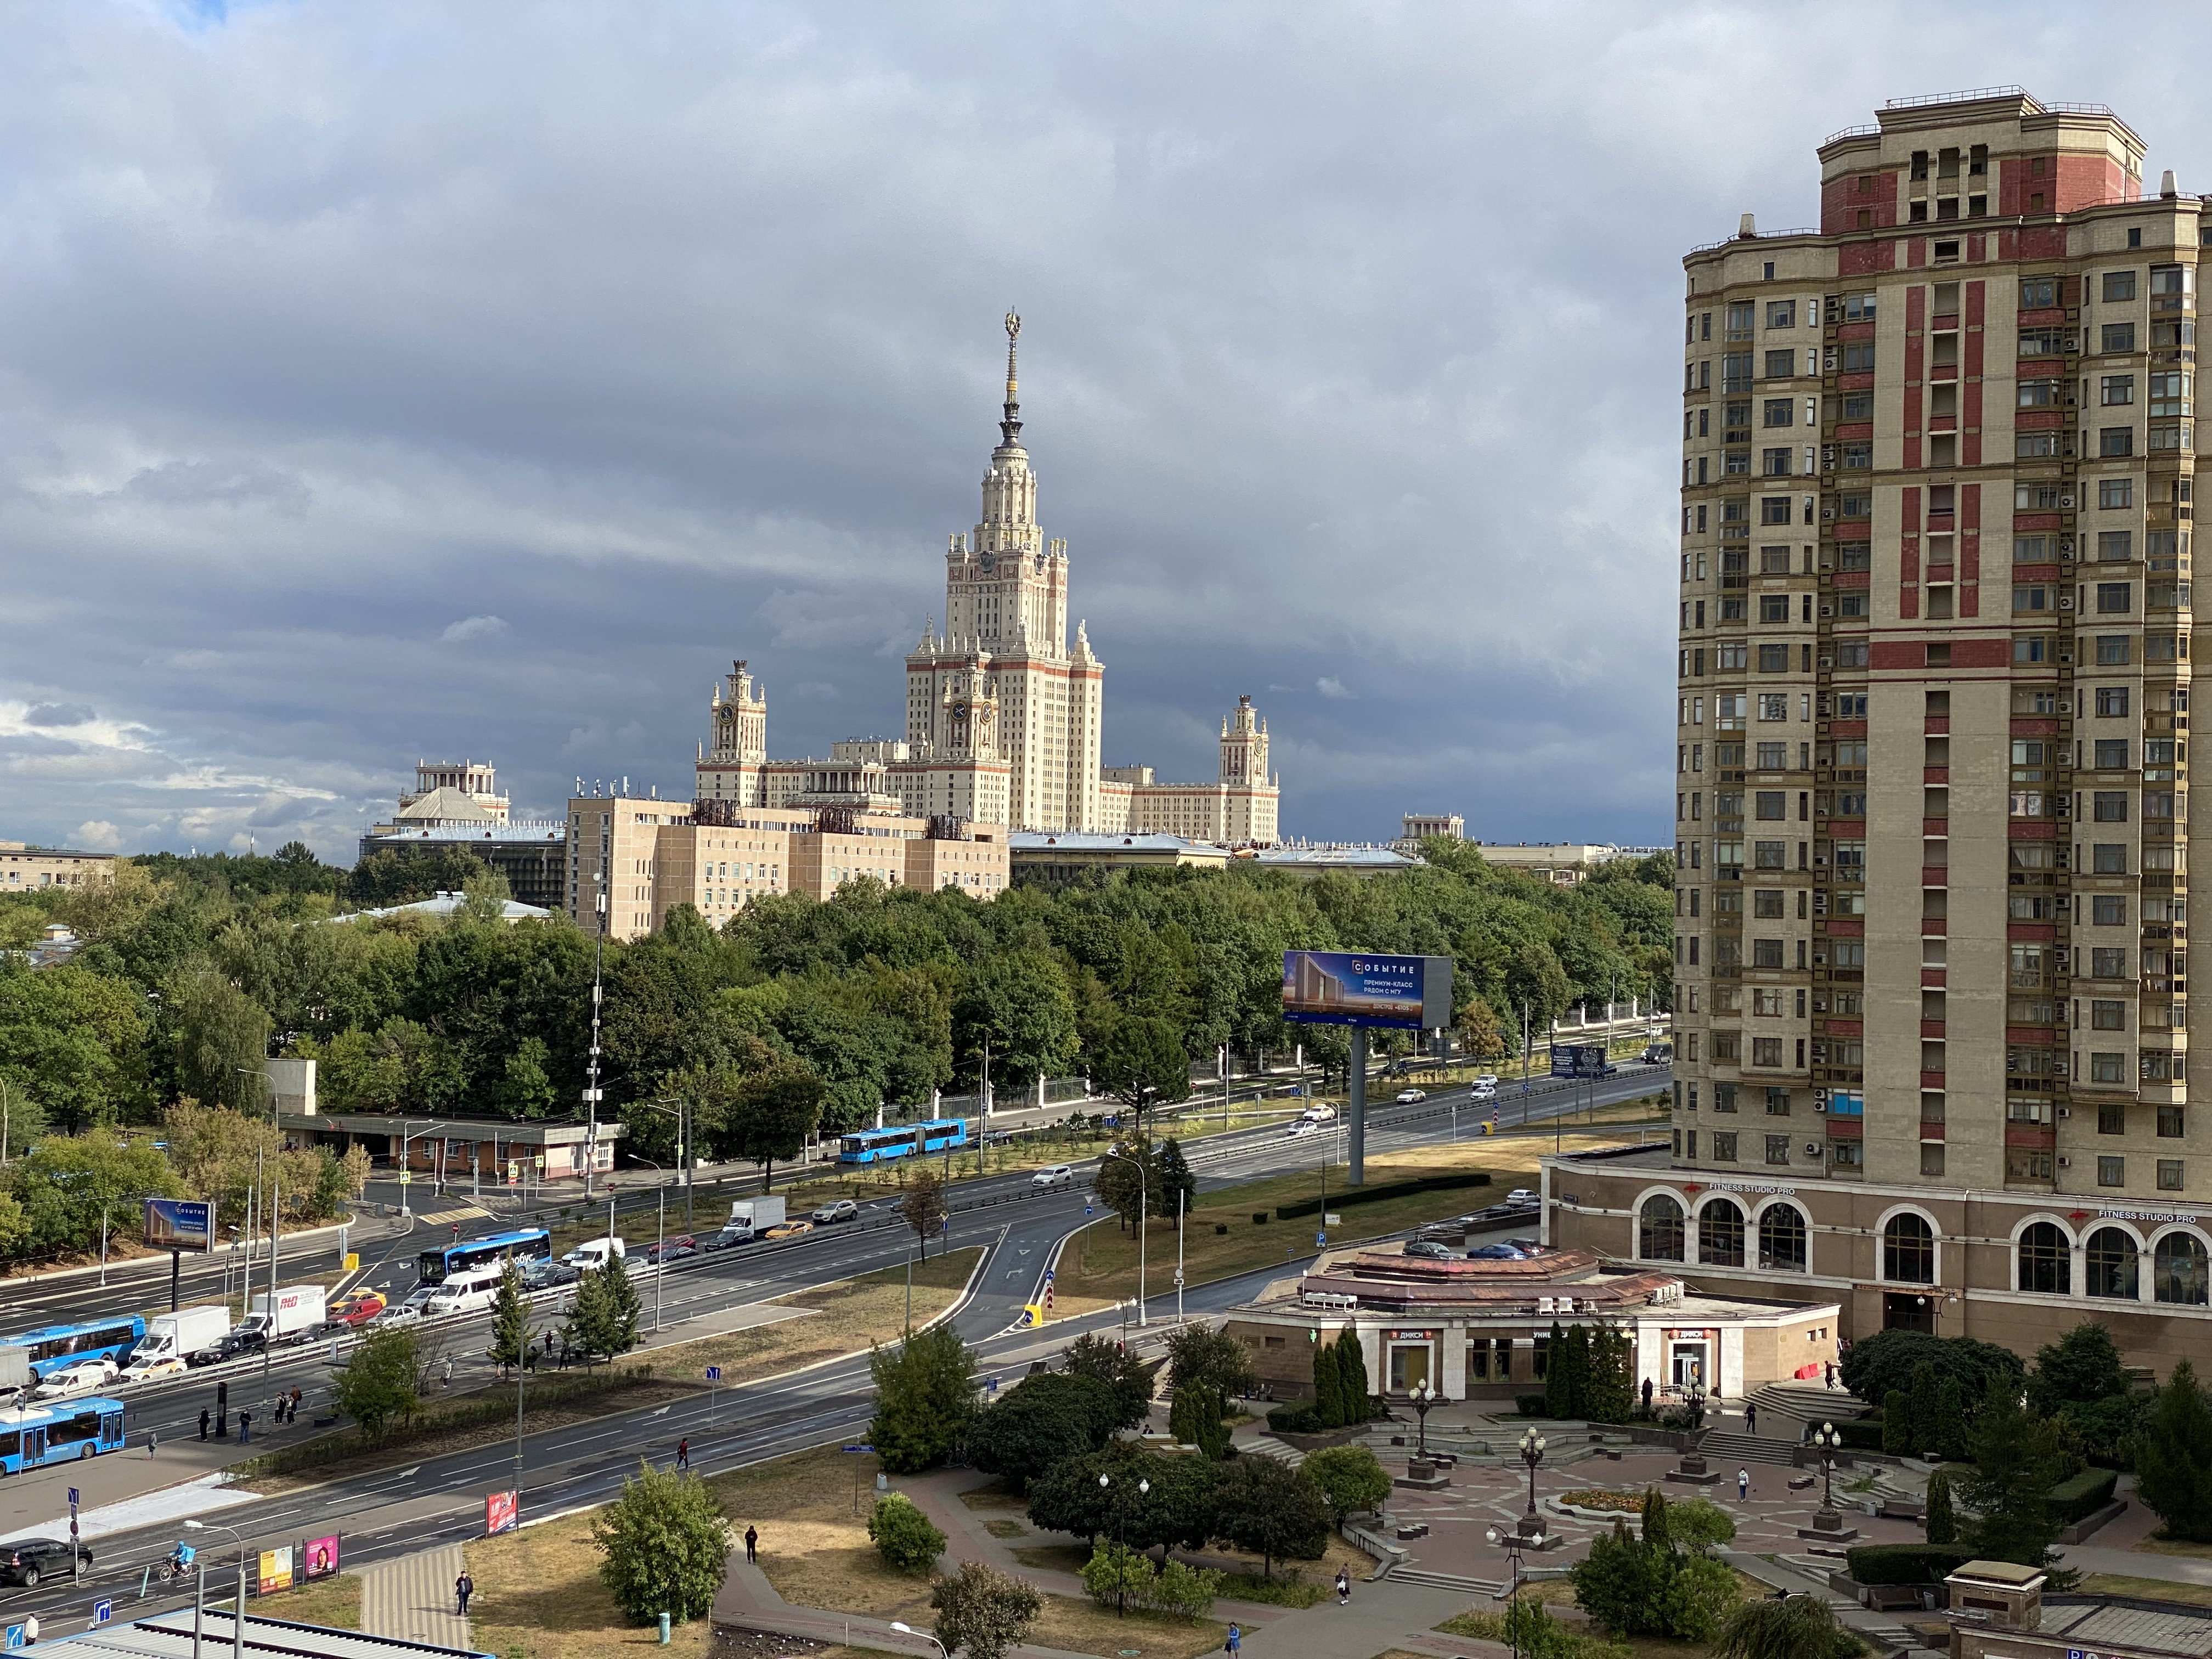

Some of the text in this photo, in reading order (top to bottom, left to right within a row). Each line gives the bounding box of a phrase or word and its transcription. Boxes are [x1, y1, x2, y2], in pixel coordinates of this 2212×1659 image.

[1355, 963, 1414, 974] СОБЫТИЕ
[1364, 979, 1413, 988] ПРЕМИУМ-КЛАСС
[1709, 1183, 1743, 1192] FITNESS
[1745, 1185, 1775, 1194] STUDIO
[2099, 1210, 2196, 1224] FITNESS STUDIO PRO
[1319, 1234, 1324, 1242] P
